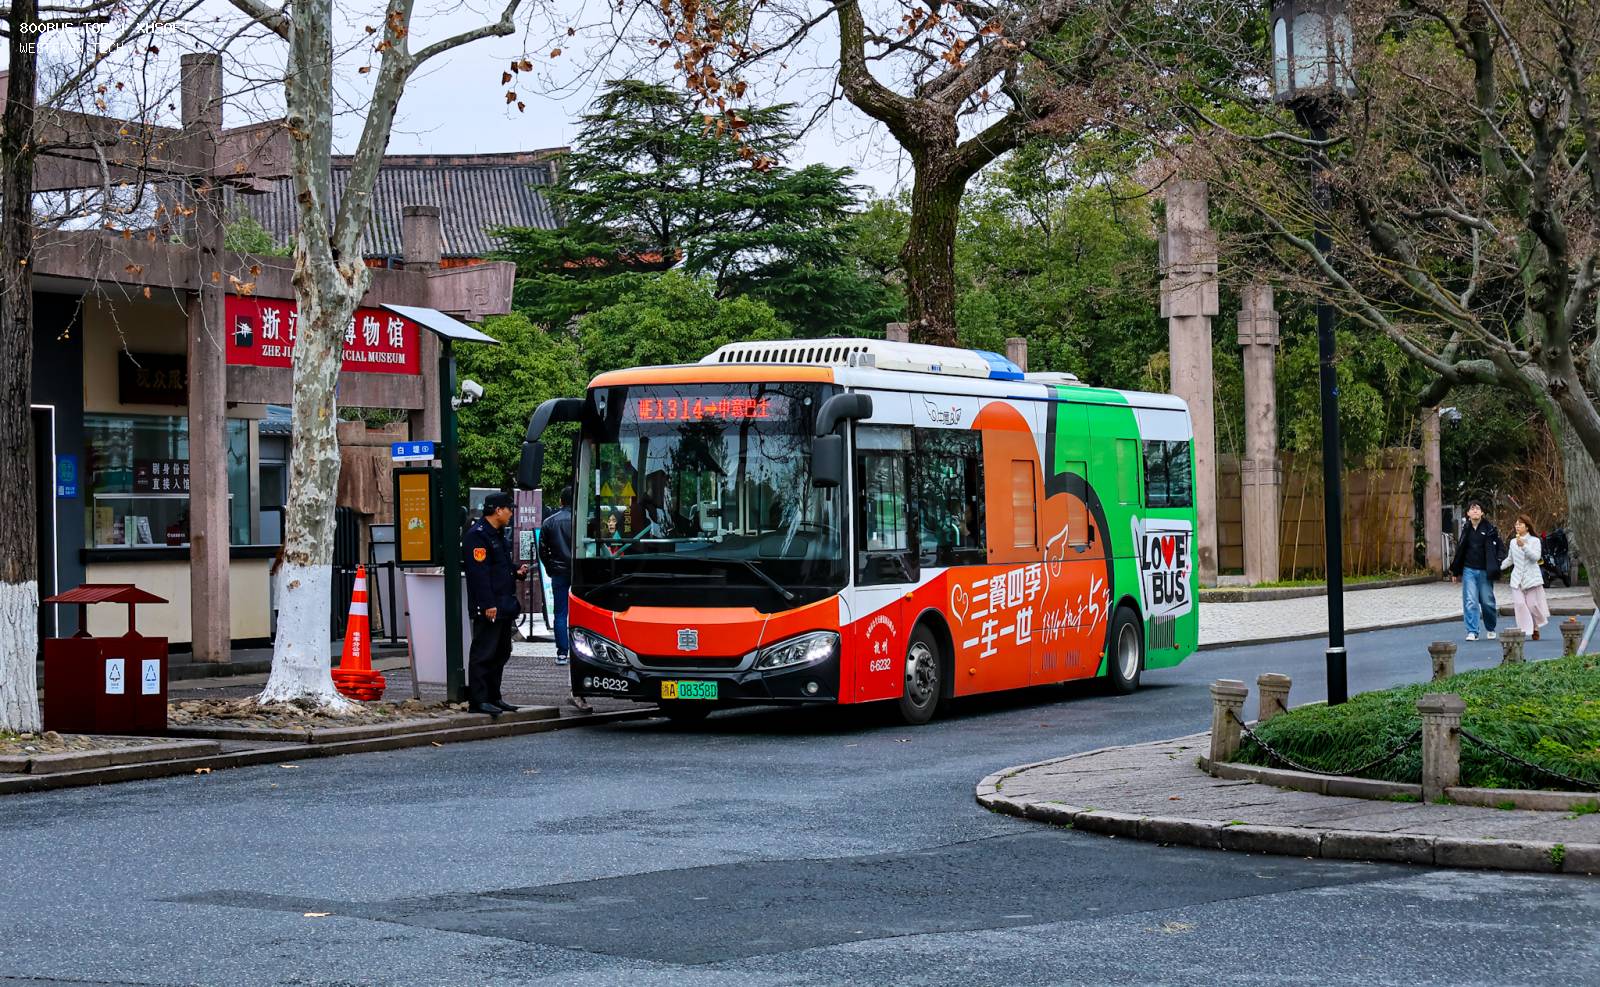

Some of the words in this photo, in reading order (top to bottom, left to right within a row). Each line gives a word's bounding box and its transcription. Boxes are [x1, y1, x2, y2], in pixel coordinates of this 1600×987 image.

[262, 345, 281, 357] ZHE
[368, 351, 405, 363] MUSEUM
[152, 478, 190, 490] 直接入馆
[971, 562, 1042, 620] 三餐四季
[1152, 569, 1185, 605] BUS
[962, 605, 1033, 659] 一生一世
[870, 657, 891, 673] 6-6232
[592, 676, 629, 692] 6-6232
